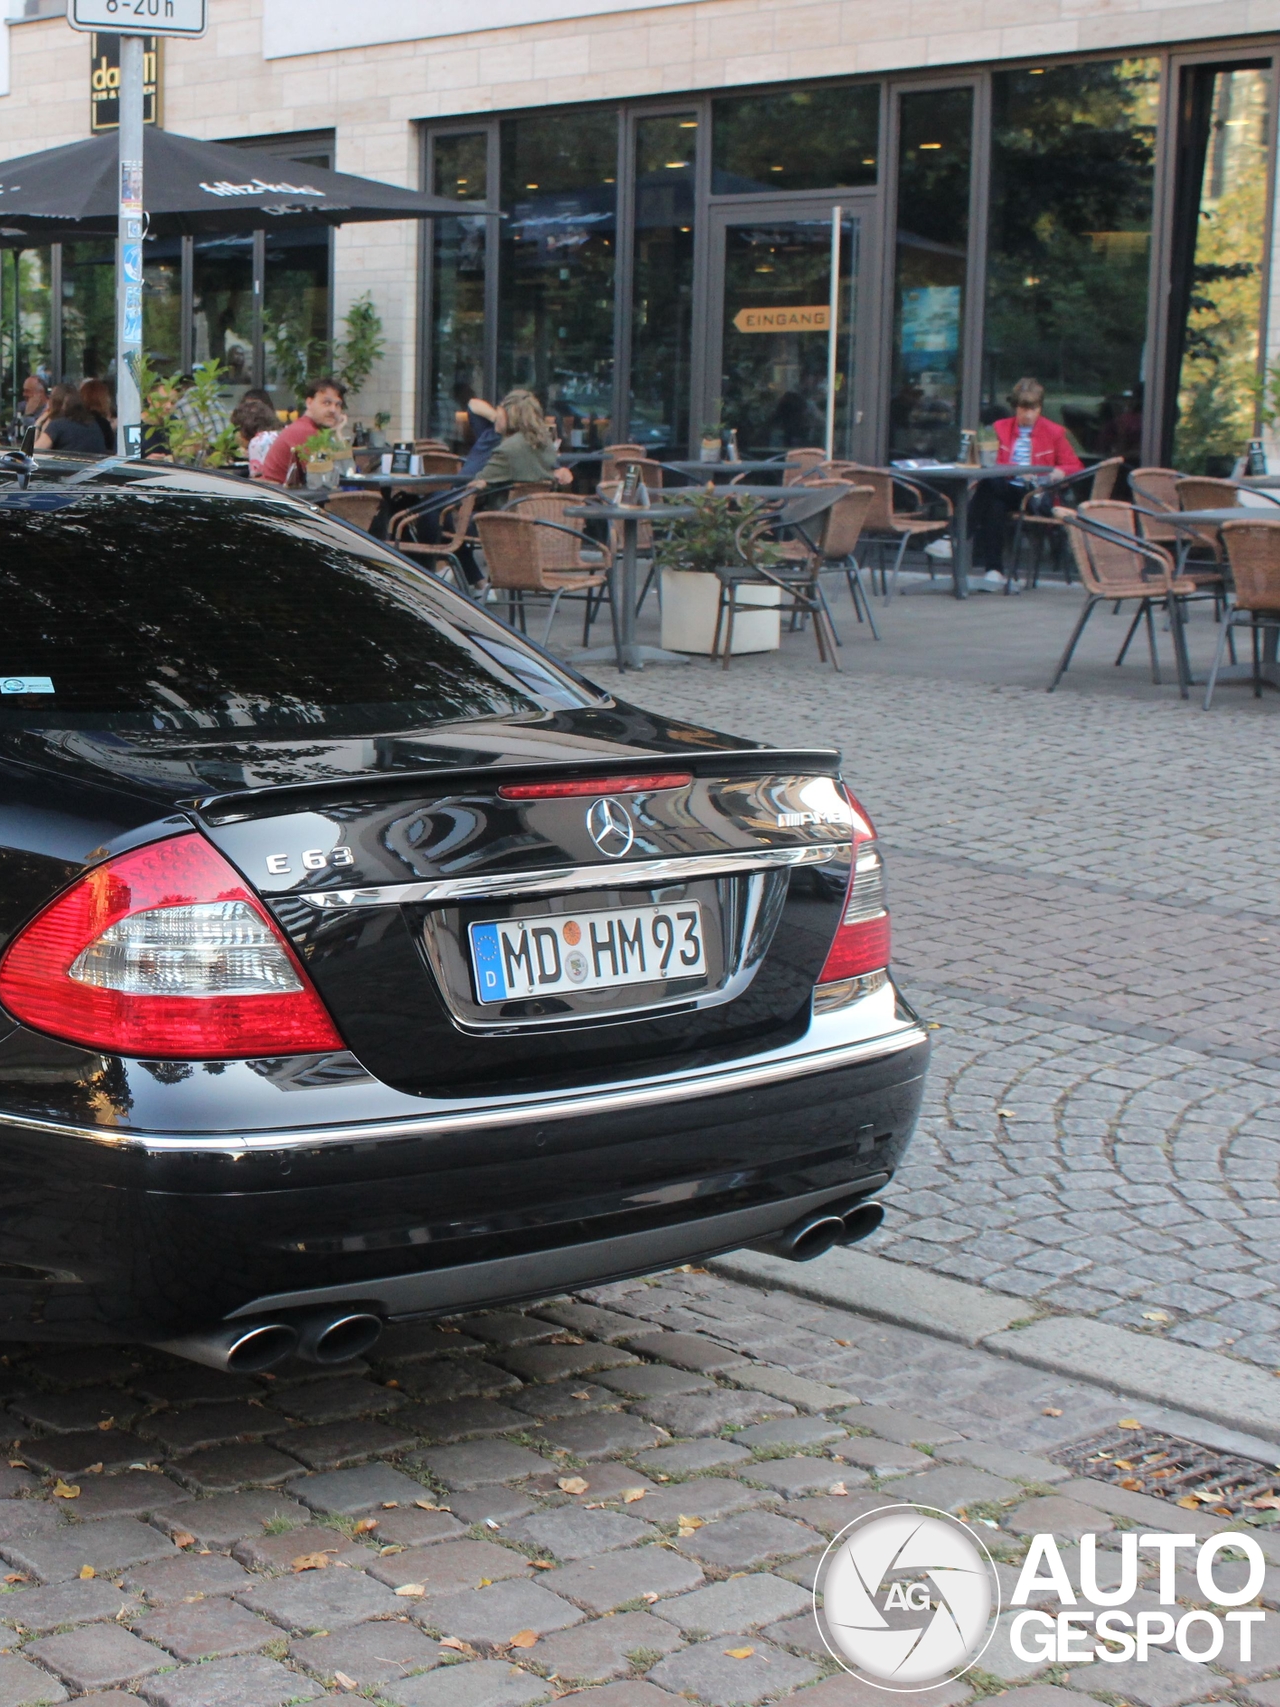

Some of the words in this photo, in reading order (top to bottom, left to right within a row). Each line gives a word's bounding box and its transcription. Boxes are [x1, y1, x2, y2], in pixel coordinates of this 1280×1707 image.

[746, 312, 825, 326] EINGANG
[265, 853, 292, 875] E
[301, 846, 355, 870] 63
[501, 926, 562, 988] MD
[588, 917, 647, 978] HM
[651, 911, 701, 970] 93
[485, 970, 497, 988] D
